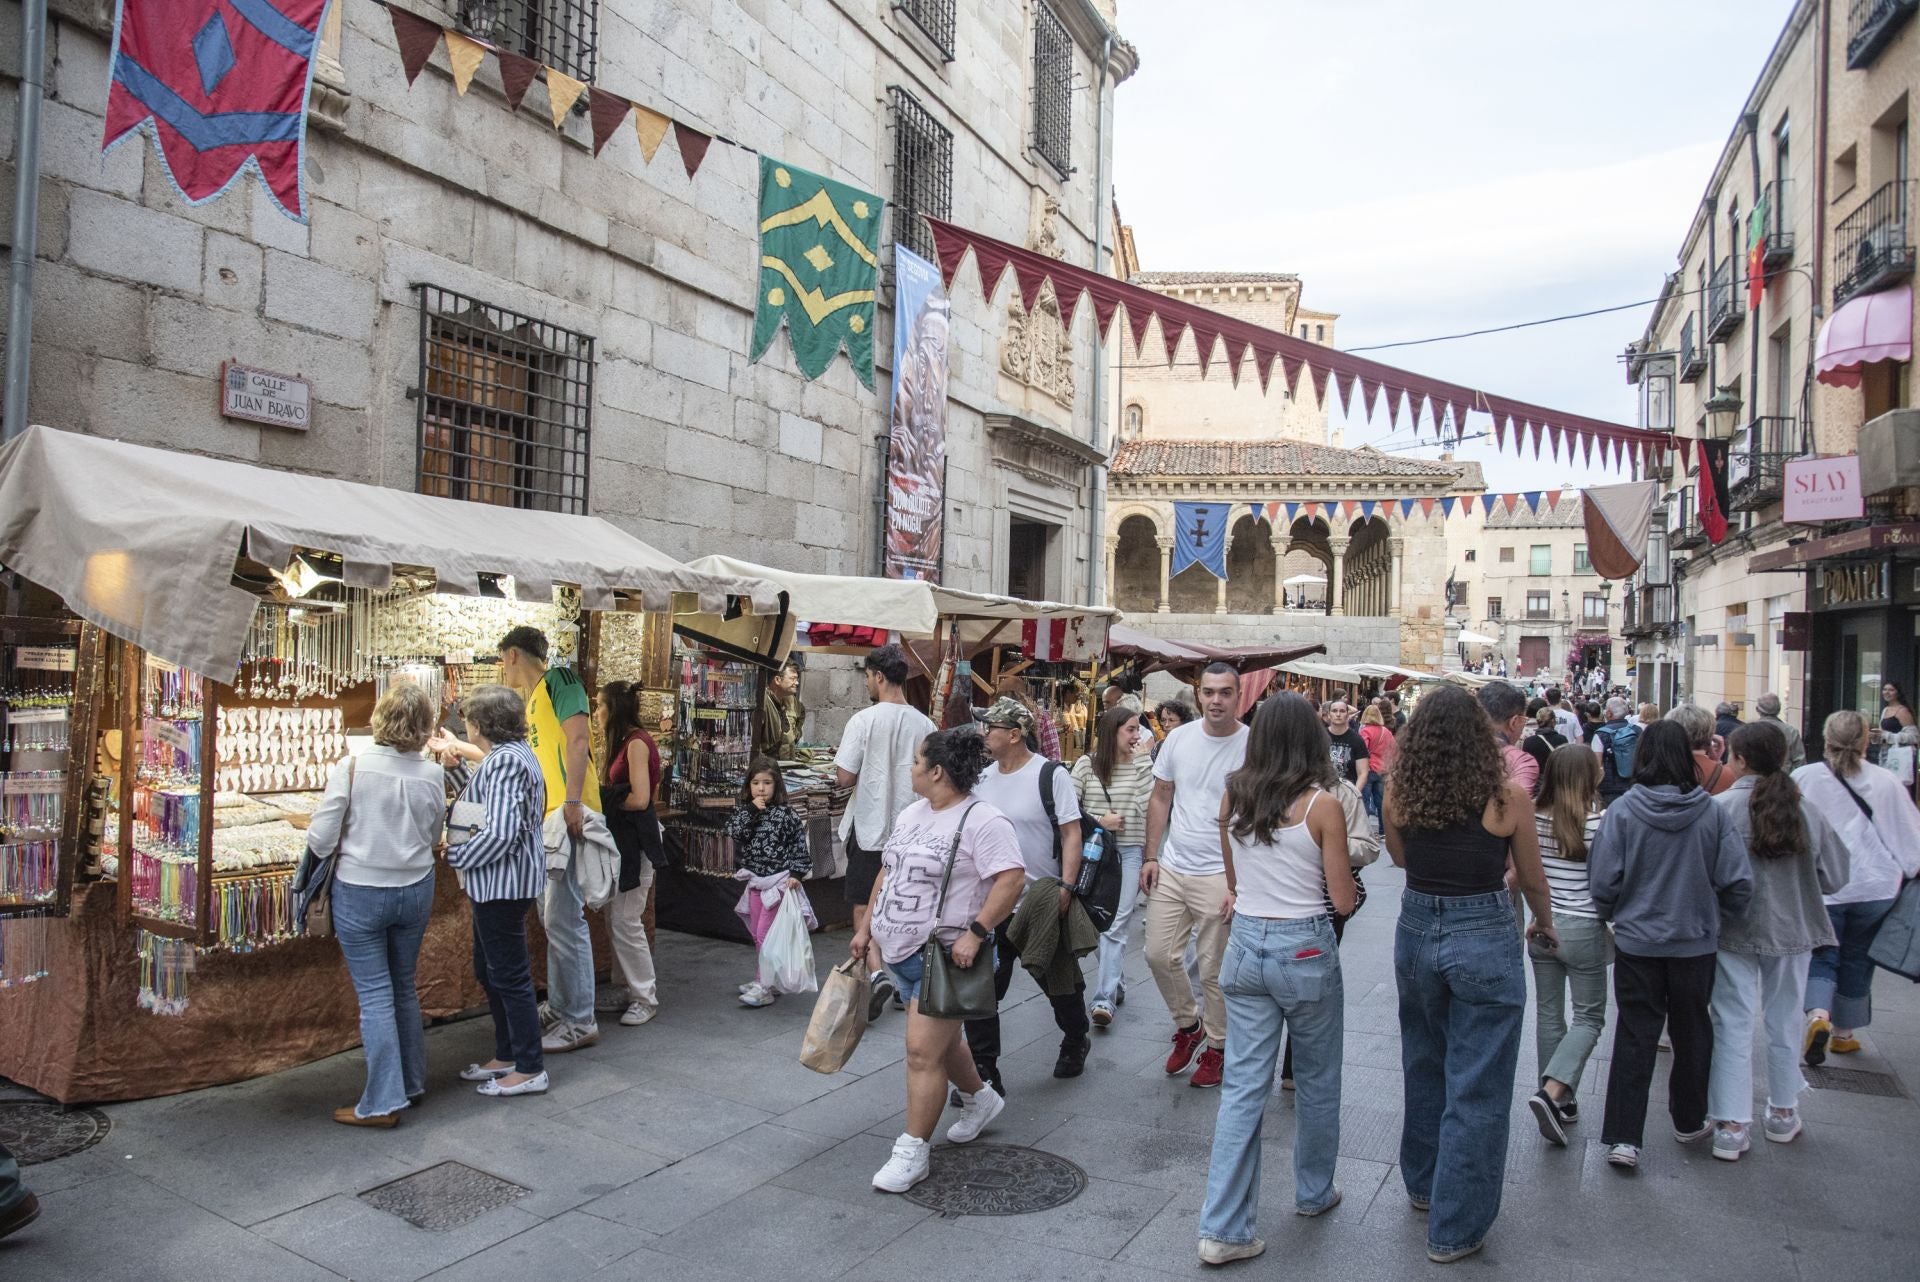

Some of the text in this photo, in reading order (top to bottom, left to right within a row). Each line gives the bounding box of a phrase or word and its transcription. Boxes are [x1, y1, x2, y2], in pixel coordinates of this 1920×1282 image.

[252, 375, 286, 392] CALLE
[262, 388, 276, 398] DE
[230, 394, 305, 420] JUAN BRAVO
[1794, 470, 1845, 494] SLAY
[874, 919, 919, 938] Angeles
